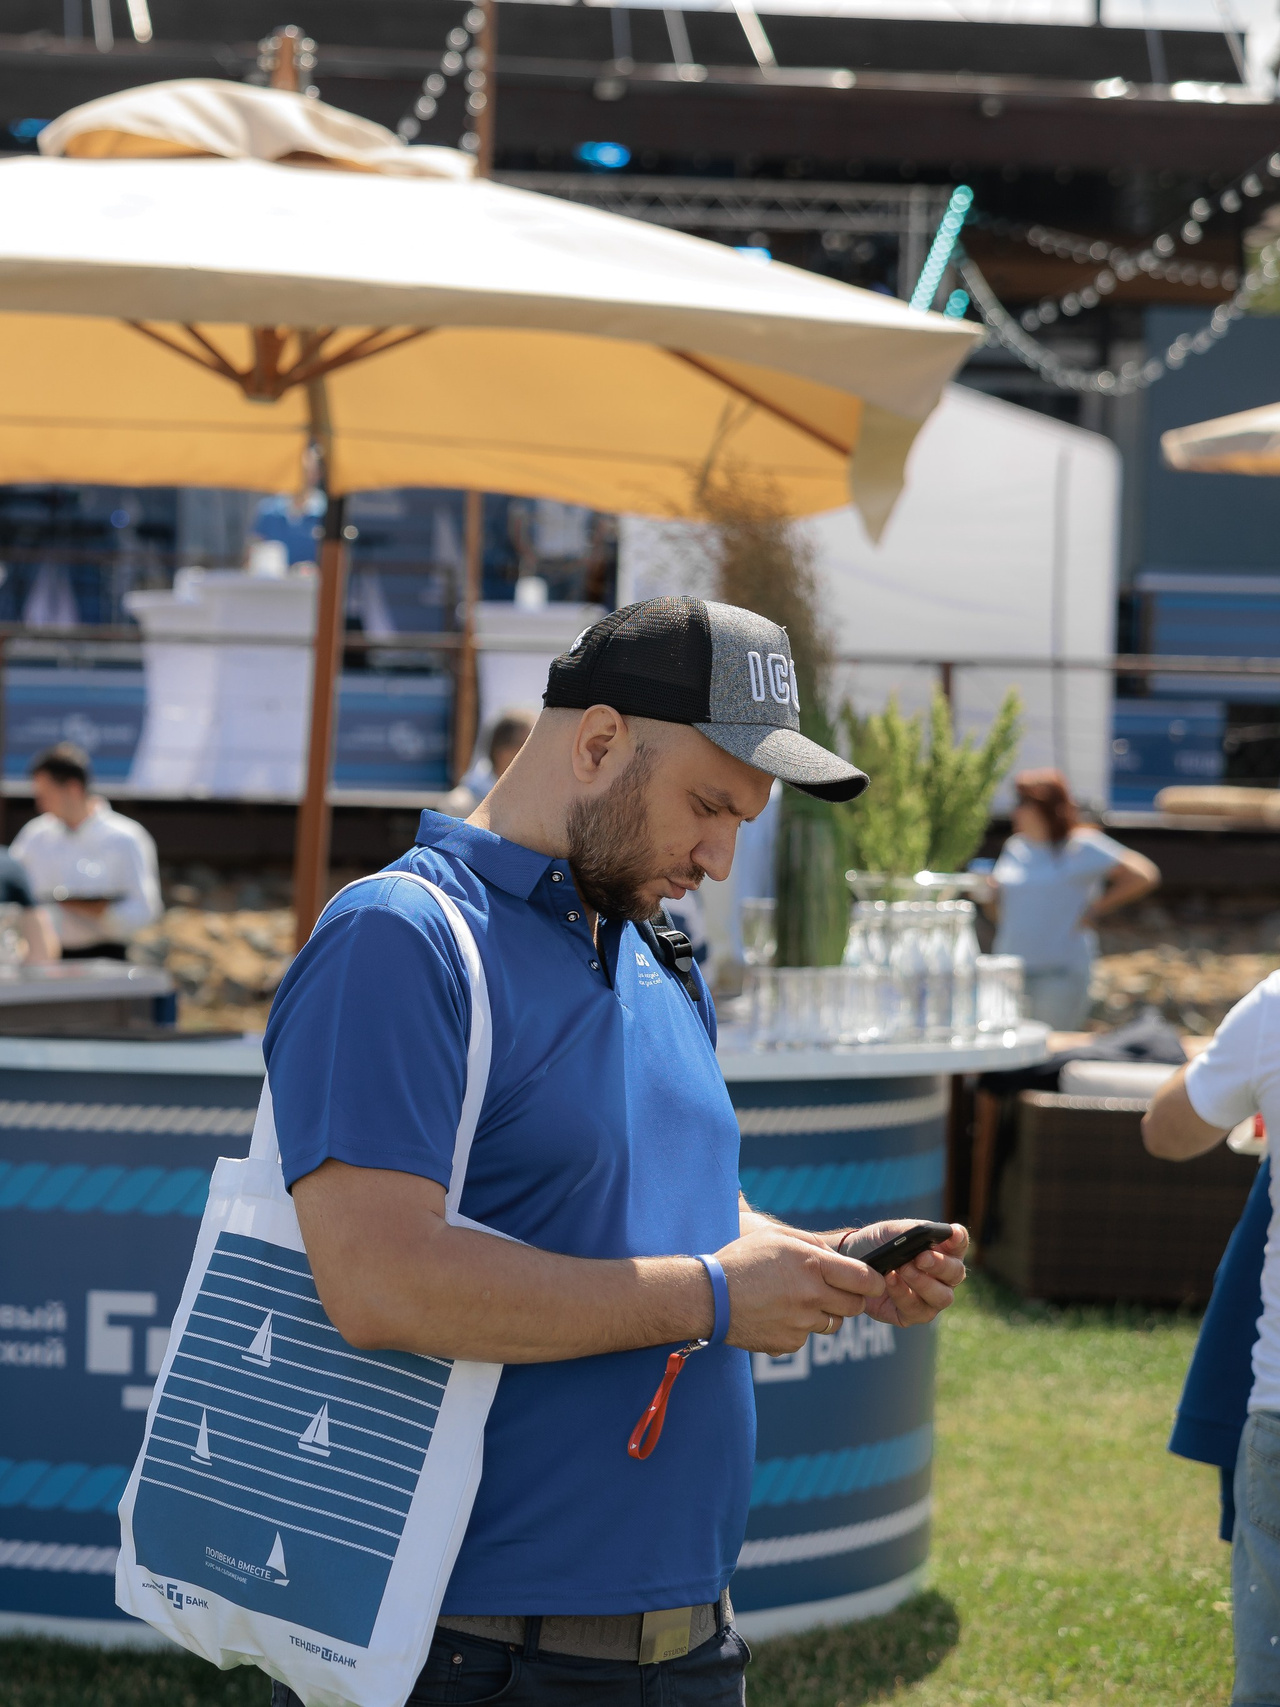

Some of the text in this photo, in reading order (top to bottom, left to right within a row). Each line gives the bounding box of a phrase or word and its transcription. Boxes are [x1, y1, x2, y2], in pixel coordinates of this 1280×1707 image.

[205, 1546, 271, 1579] ПОЛВЕКА ВМЕСТЕ
[185, 1595, 209, 1609] БАНК
[289, 1635, 357, 1669] ТЕНДЕР БАНК
[663, 1645, 687, 1658] STUDIO
